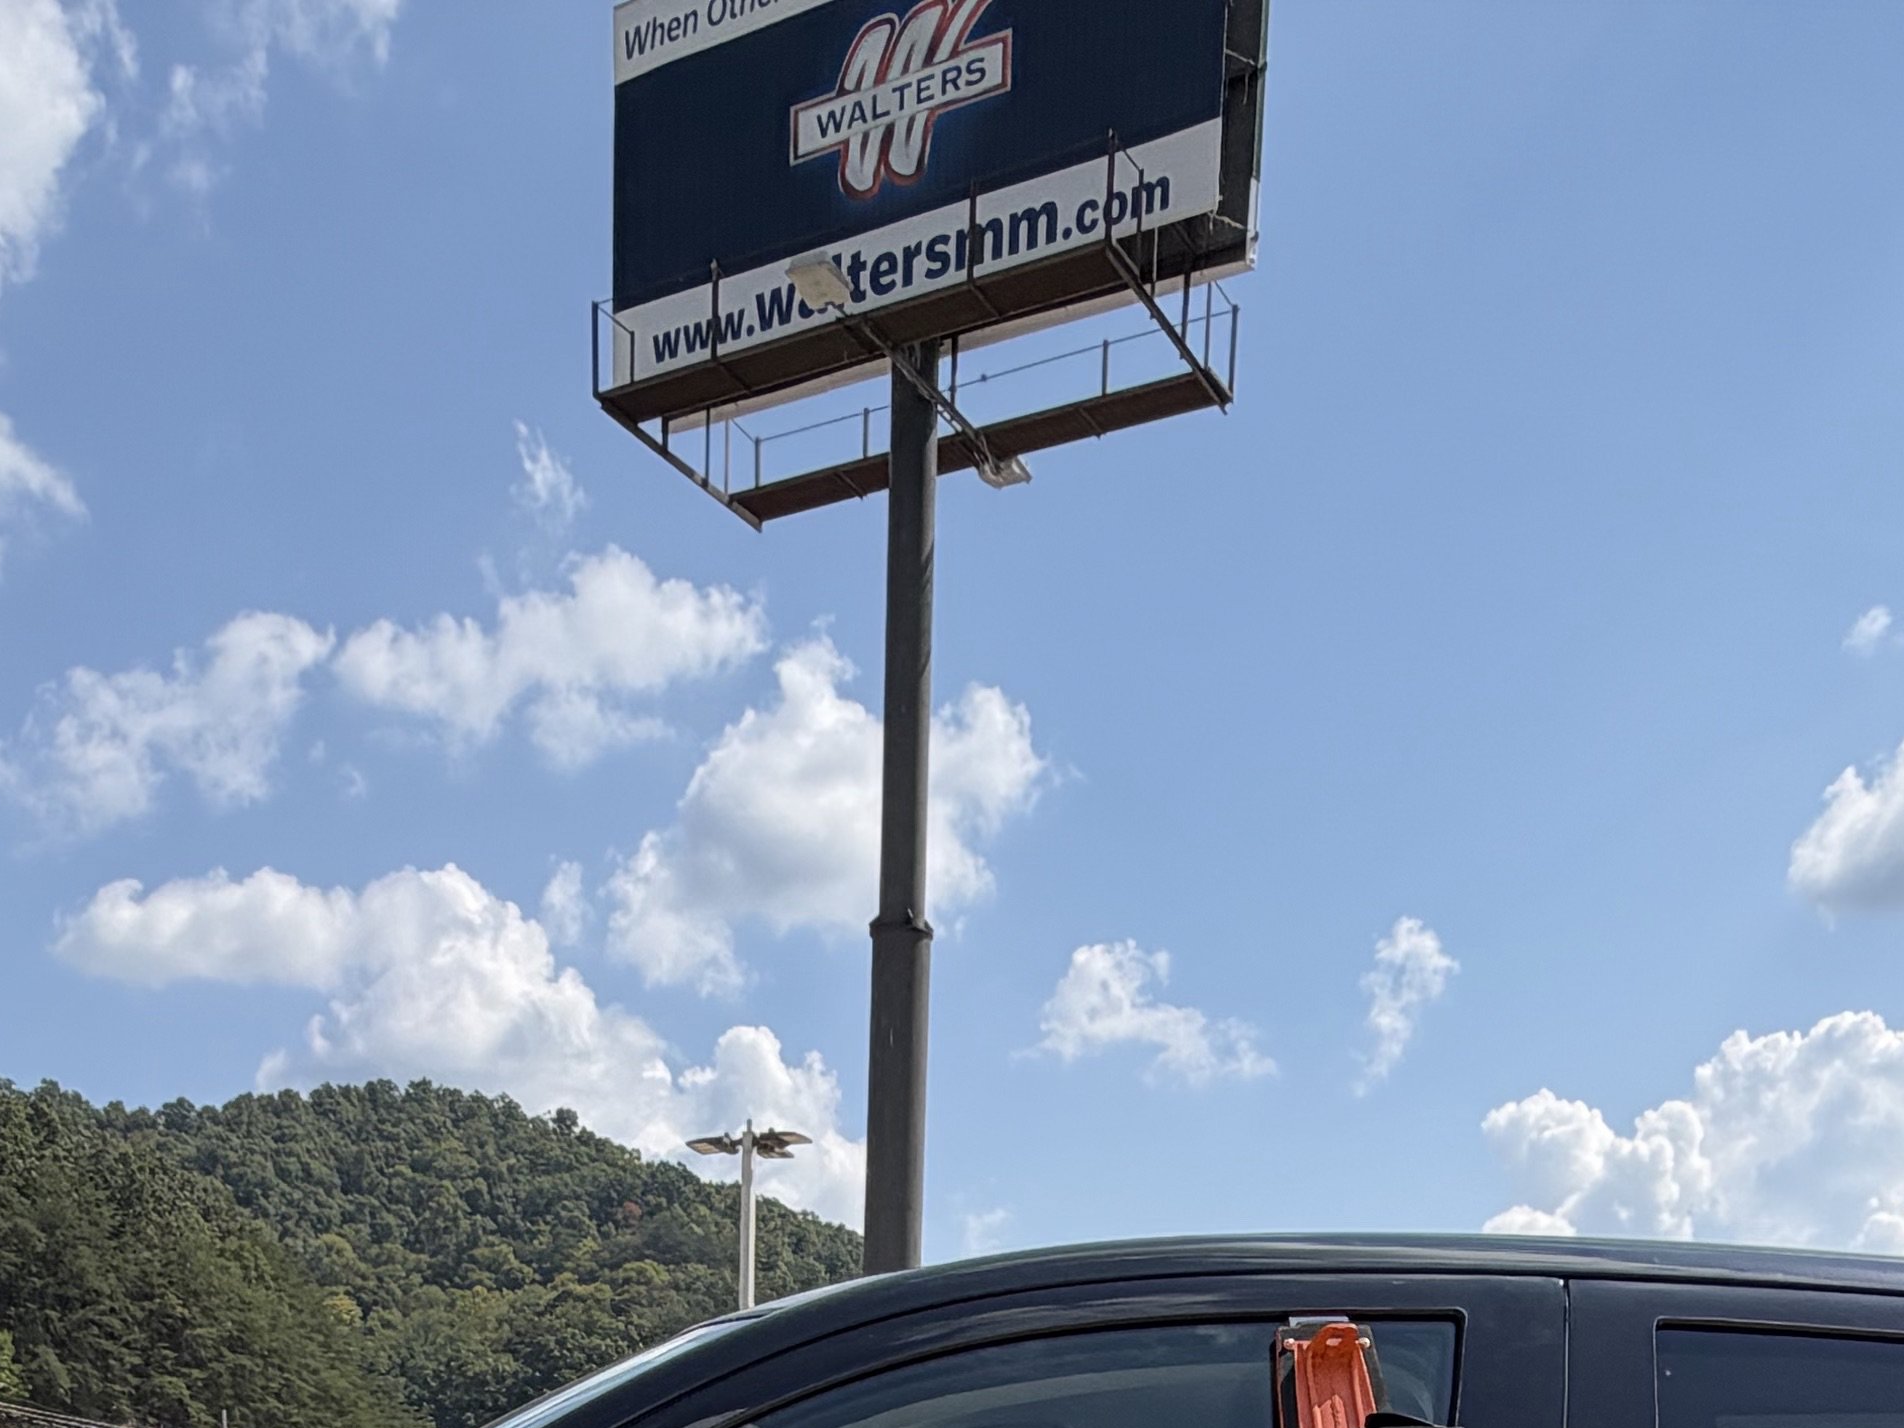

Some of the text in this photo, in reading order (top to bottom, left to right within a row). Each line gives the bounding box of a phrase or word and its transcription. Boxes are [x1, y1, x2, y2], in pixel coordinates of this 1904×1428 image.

[624, 9, 698, 60] When
[816, 57, 987, 139] WALTERS
[652, 175, 1170, 364] www.wtersmm.com
